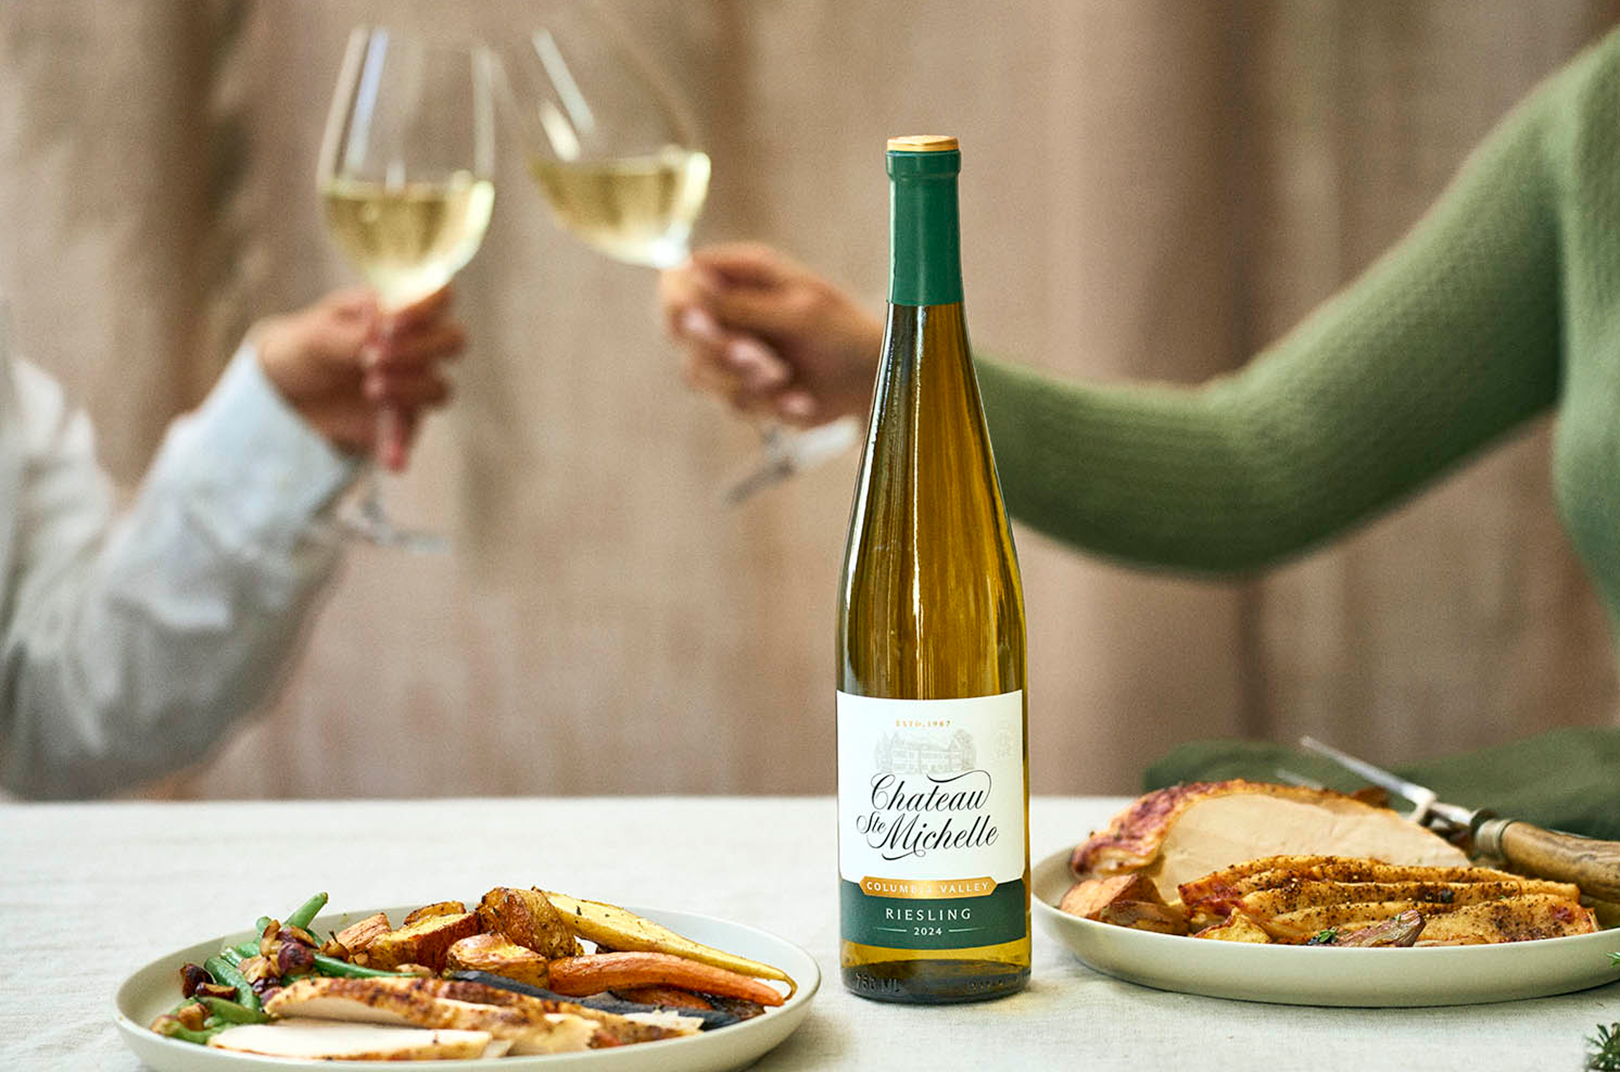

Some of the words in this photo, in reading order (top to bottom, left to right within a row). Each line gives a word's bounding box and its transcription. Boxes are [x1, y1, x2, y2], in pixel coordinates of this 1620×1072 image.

[871, 770, 992, 812] Chateau
[856, 811, 887, 834] Ste
[866, 813, 1000, 861] Michelle
[866, 881, 933, 894] COLUMBIA
[940, 881, 989, 894] VALLEY
[885, 907, 971, 921] RIESLING
[913, 926, 943, 936] 2024
